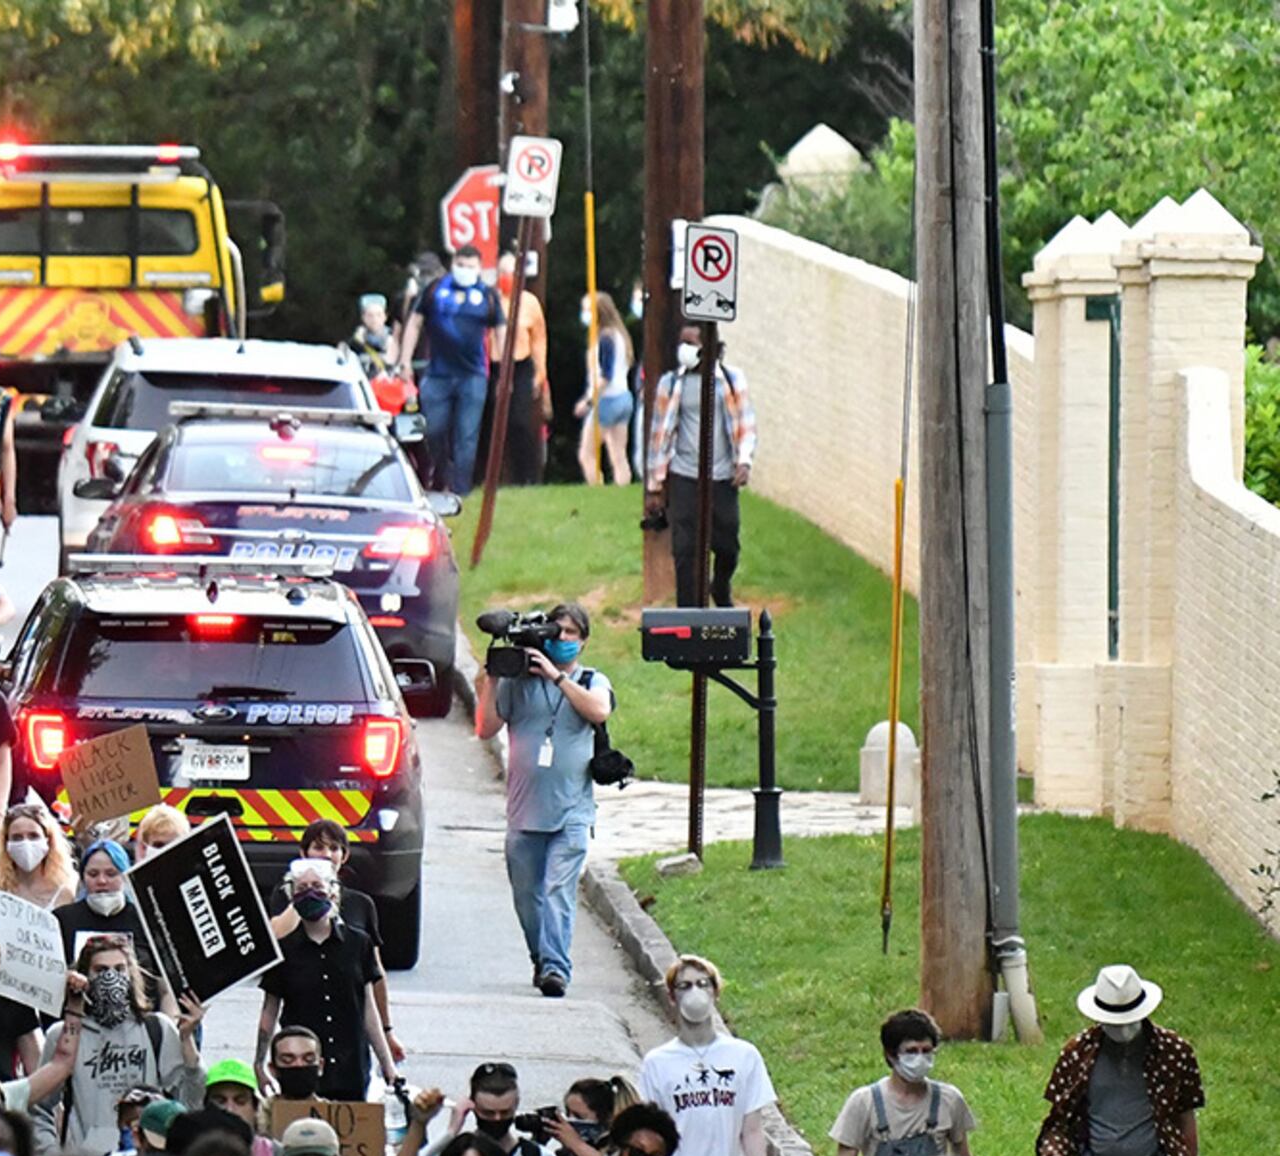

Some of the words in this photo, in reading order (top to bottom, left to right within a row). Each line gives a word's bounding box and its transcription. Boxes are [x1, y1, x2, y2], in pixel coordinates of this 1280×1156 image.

[245, 703, 355, 725] POLICE
[67, 733, 132, 776] BLACK
[80, 763, 127, 792] LIVES
[77, 782, 139, 814] MATTER
[185, 883, 221, 950] MATTER
[201, 842, 237, 900] BLACK
[226, 905, 257, 956] LIVES
